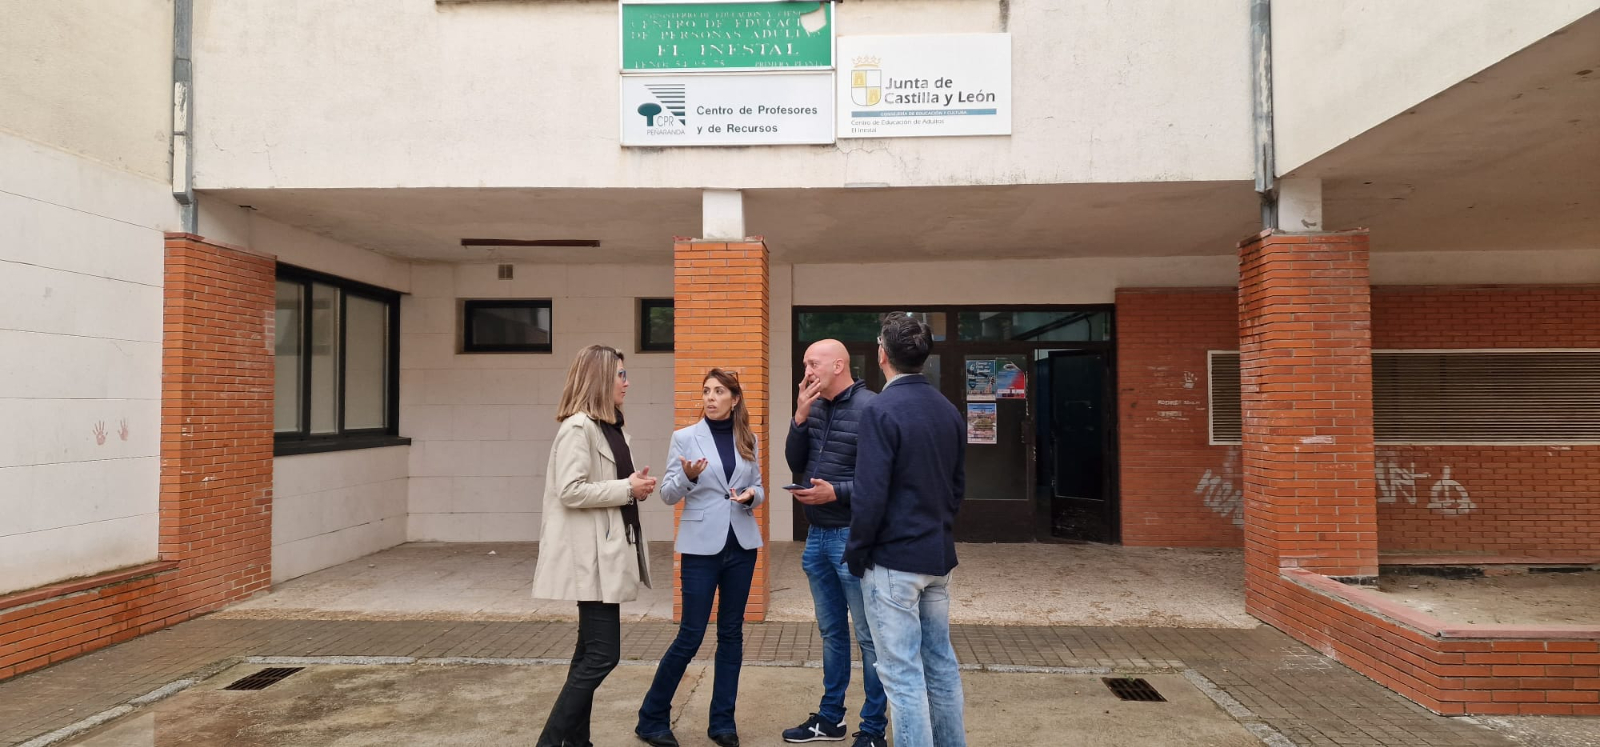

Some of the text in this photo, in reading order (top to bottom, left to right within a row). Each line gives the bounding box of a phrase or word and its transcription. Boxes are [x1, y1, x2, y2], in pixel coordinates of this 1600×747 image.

[631, 18, 801, 29] CENTRO DE EDUCACI
[631, 31, 649, 39] DE
[661, 30, 741, 39] PERSONAS
[658, 43, 799, 56] EL INESTAL
[755, 60, 789, 68] PRIMERA
[885, 77, 953, 90] Junta de
[884, 89, 996, 106] Castilla y León
[696, 104, 818, 115] Centro de Profesores
[656, 115, 675, 127] CPR
[881, 117, 912, 126] Educación
[913, 117, 921, 125] de
[922, 117, 945, 125] Adultos
[646, 127, 686, 136] PEÑARANDA
[696, 123, 778, 135] y de Recursos
